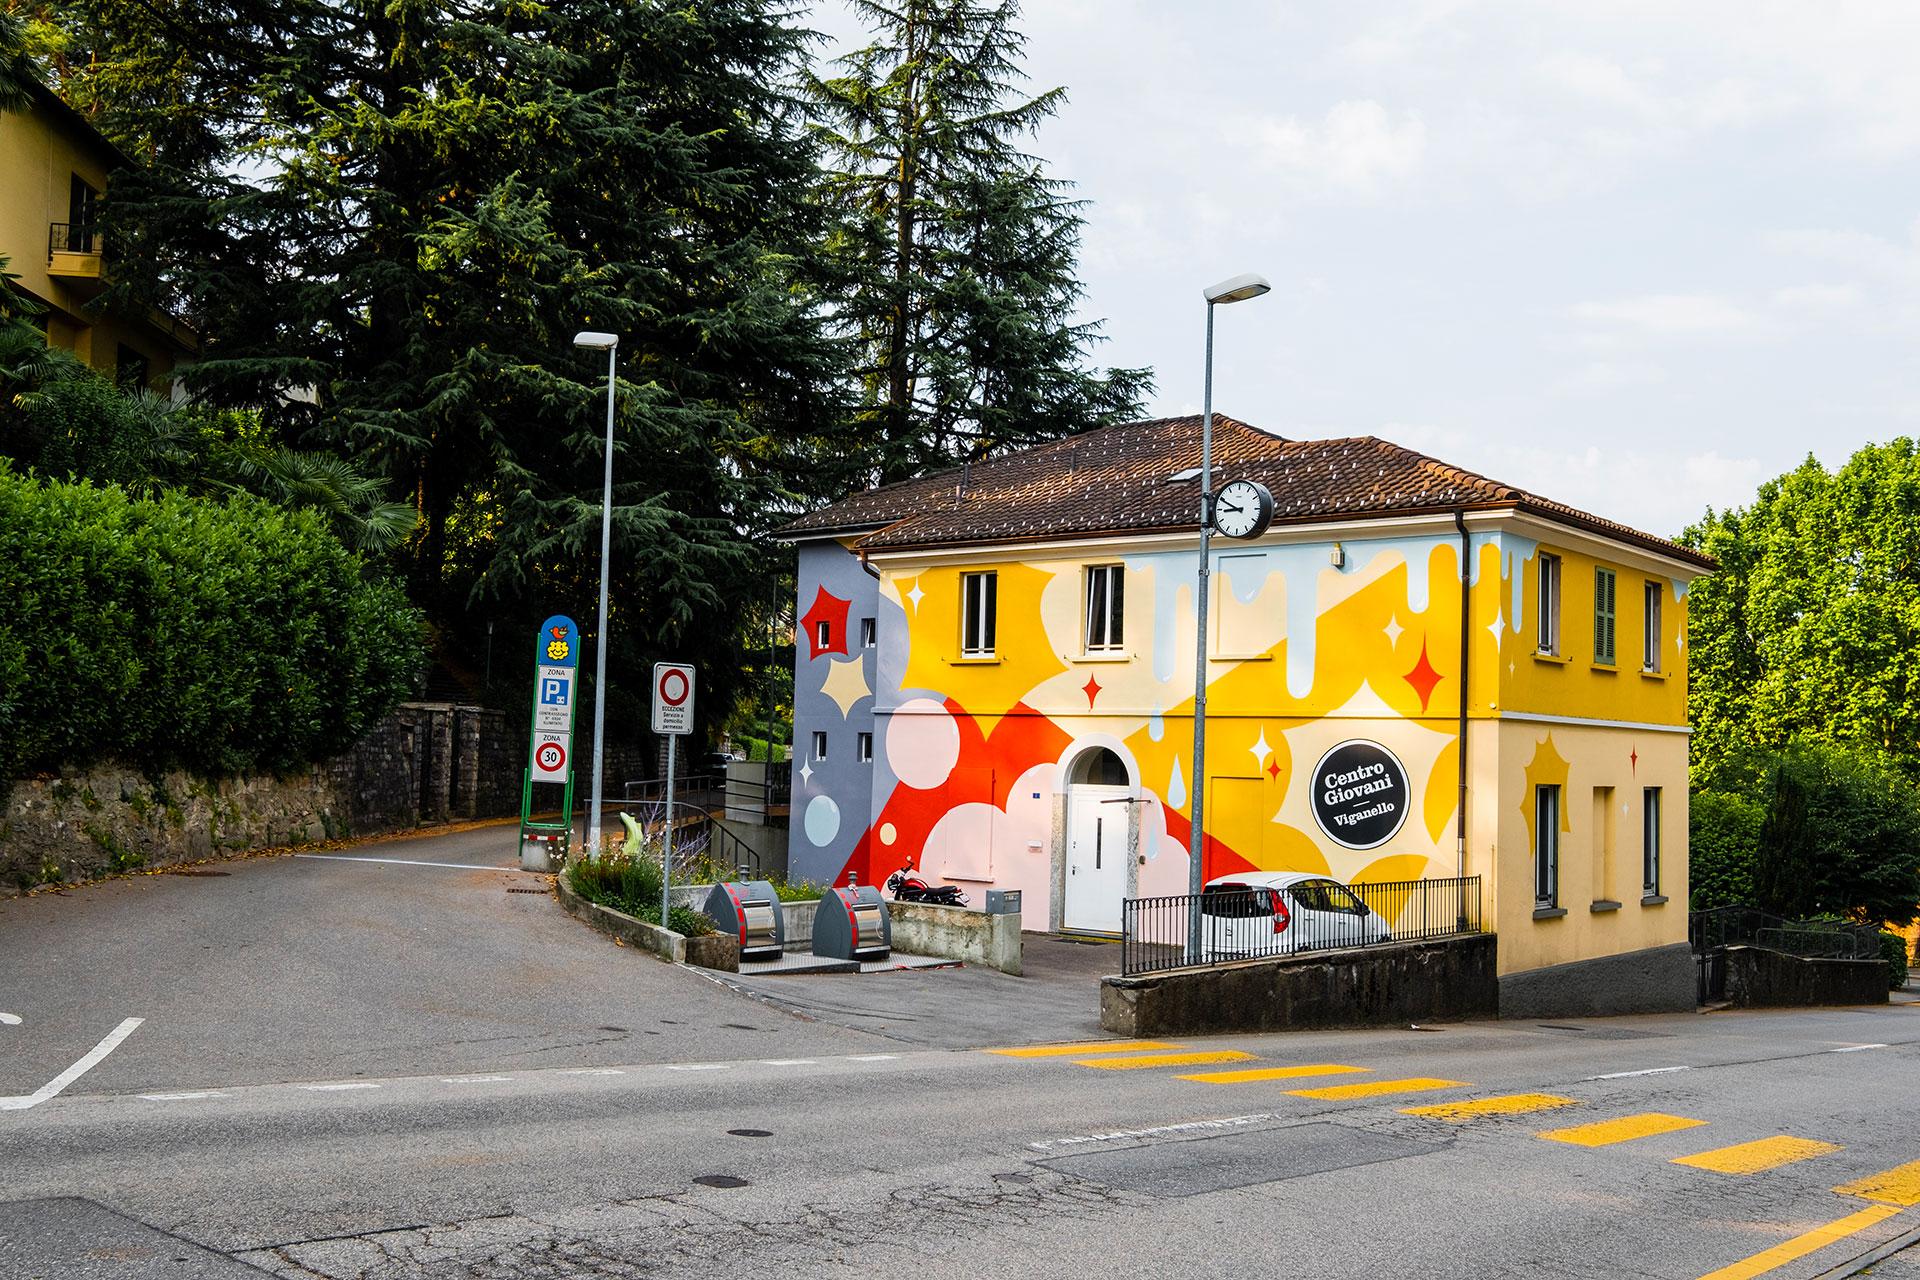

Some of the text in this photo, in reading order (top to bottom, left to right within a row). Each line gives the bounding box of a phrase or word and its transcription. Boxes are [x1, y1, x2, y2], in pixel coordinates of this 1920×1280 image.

[545, 680, 560, 701] P
[544, 751, 557, 762] 30
[1325, 763, 1384, 789] Centro
[1324, 774, 1394, 806] Giovani
[1334, 802, 1395, 826] Viganello
